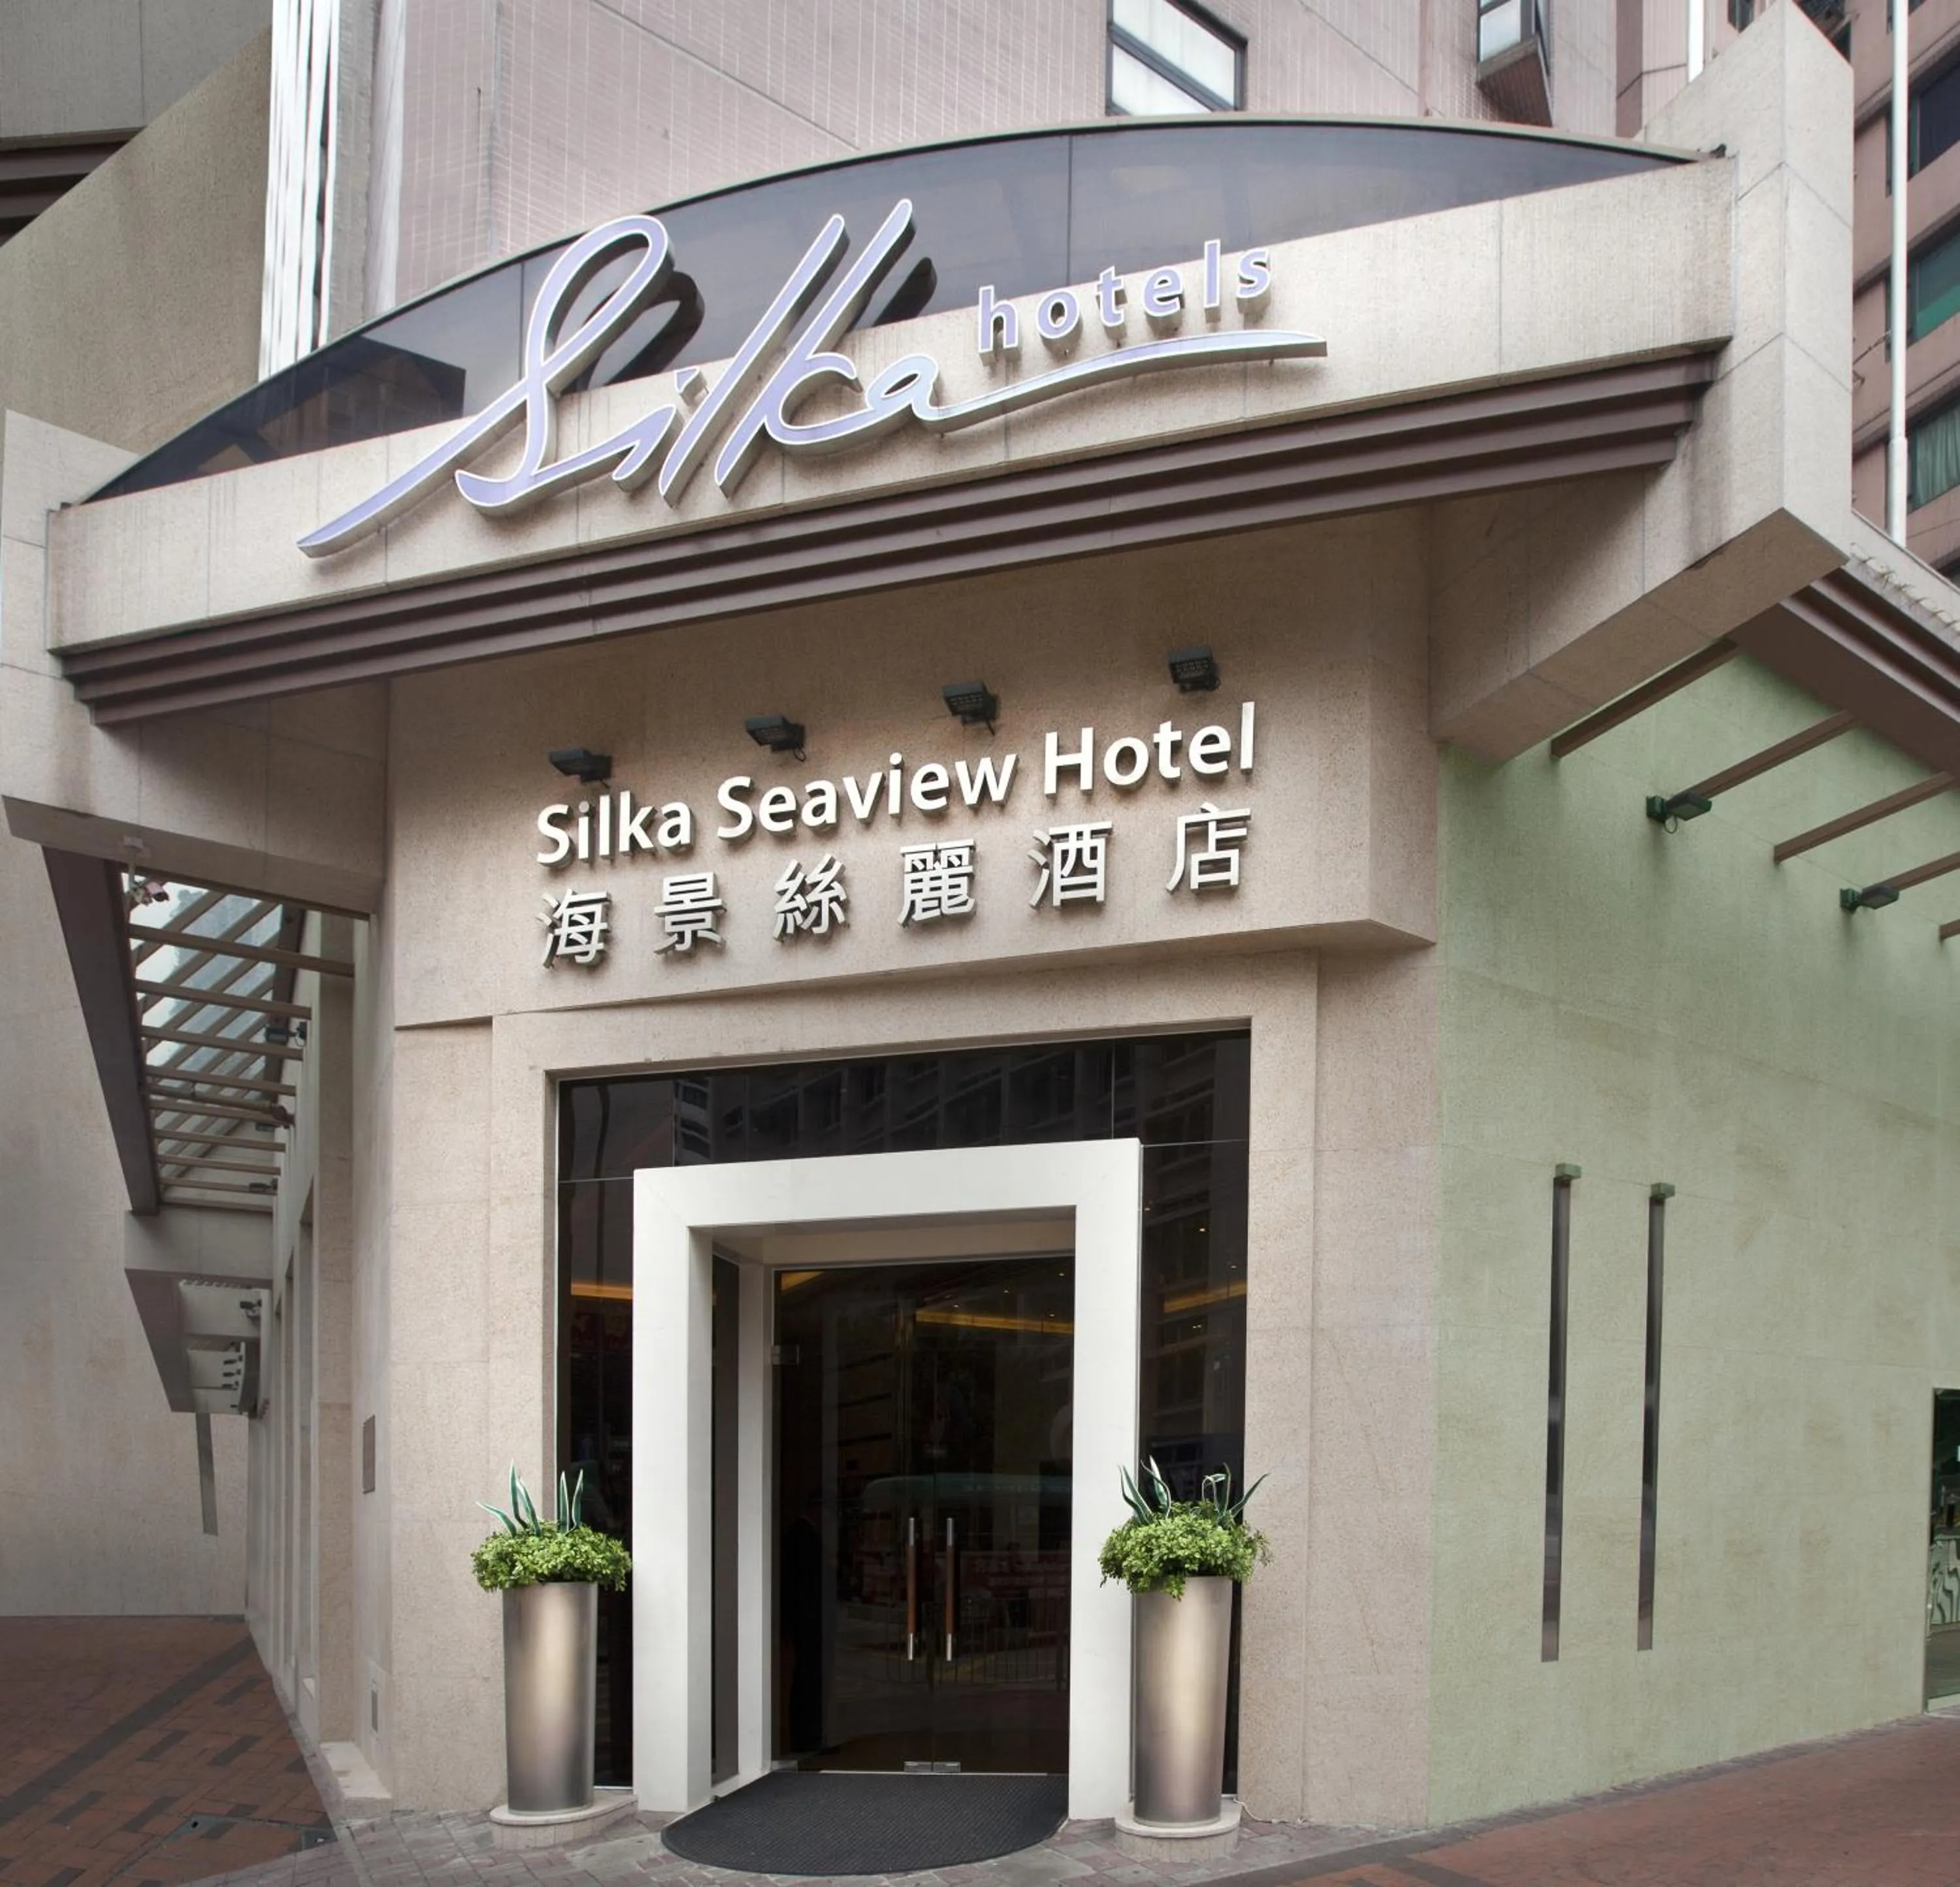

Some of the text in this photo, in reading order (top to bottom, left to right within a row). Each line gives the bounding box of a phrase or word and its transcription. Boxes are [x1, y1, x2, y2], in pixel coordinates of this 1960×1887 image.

[297, 197, 1327, 557] Silka hotels
[536, 701, 1256, 868] Silka Seaview Hotel
[538, 802, 1252, 968] 海景絲麗酒店
